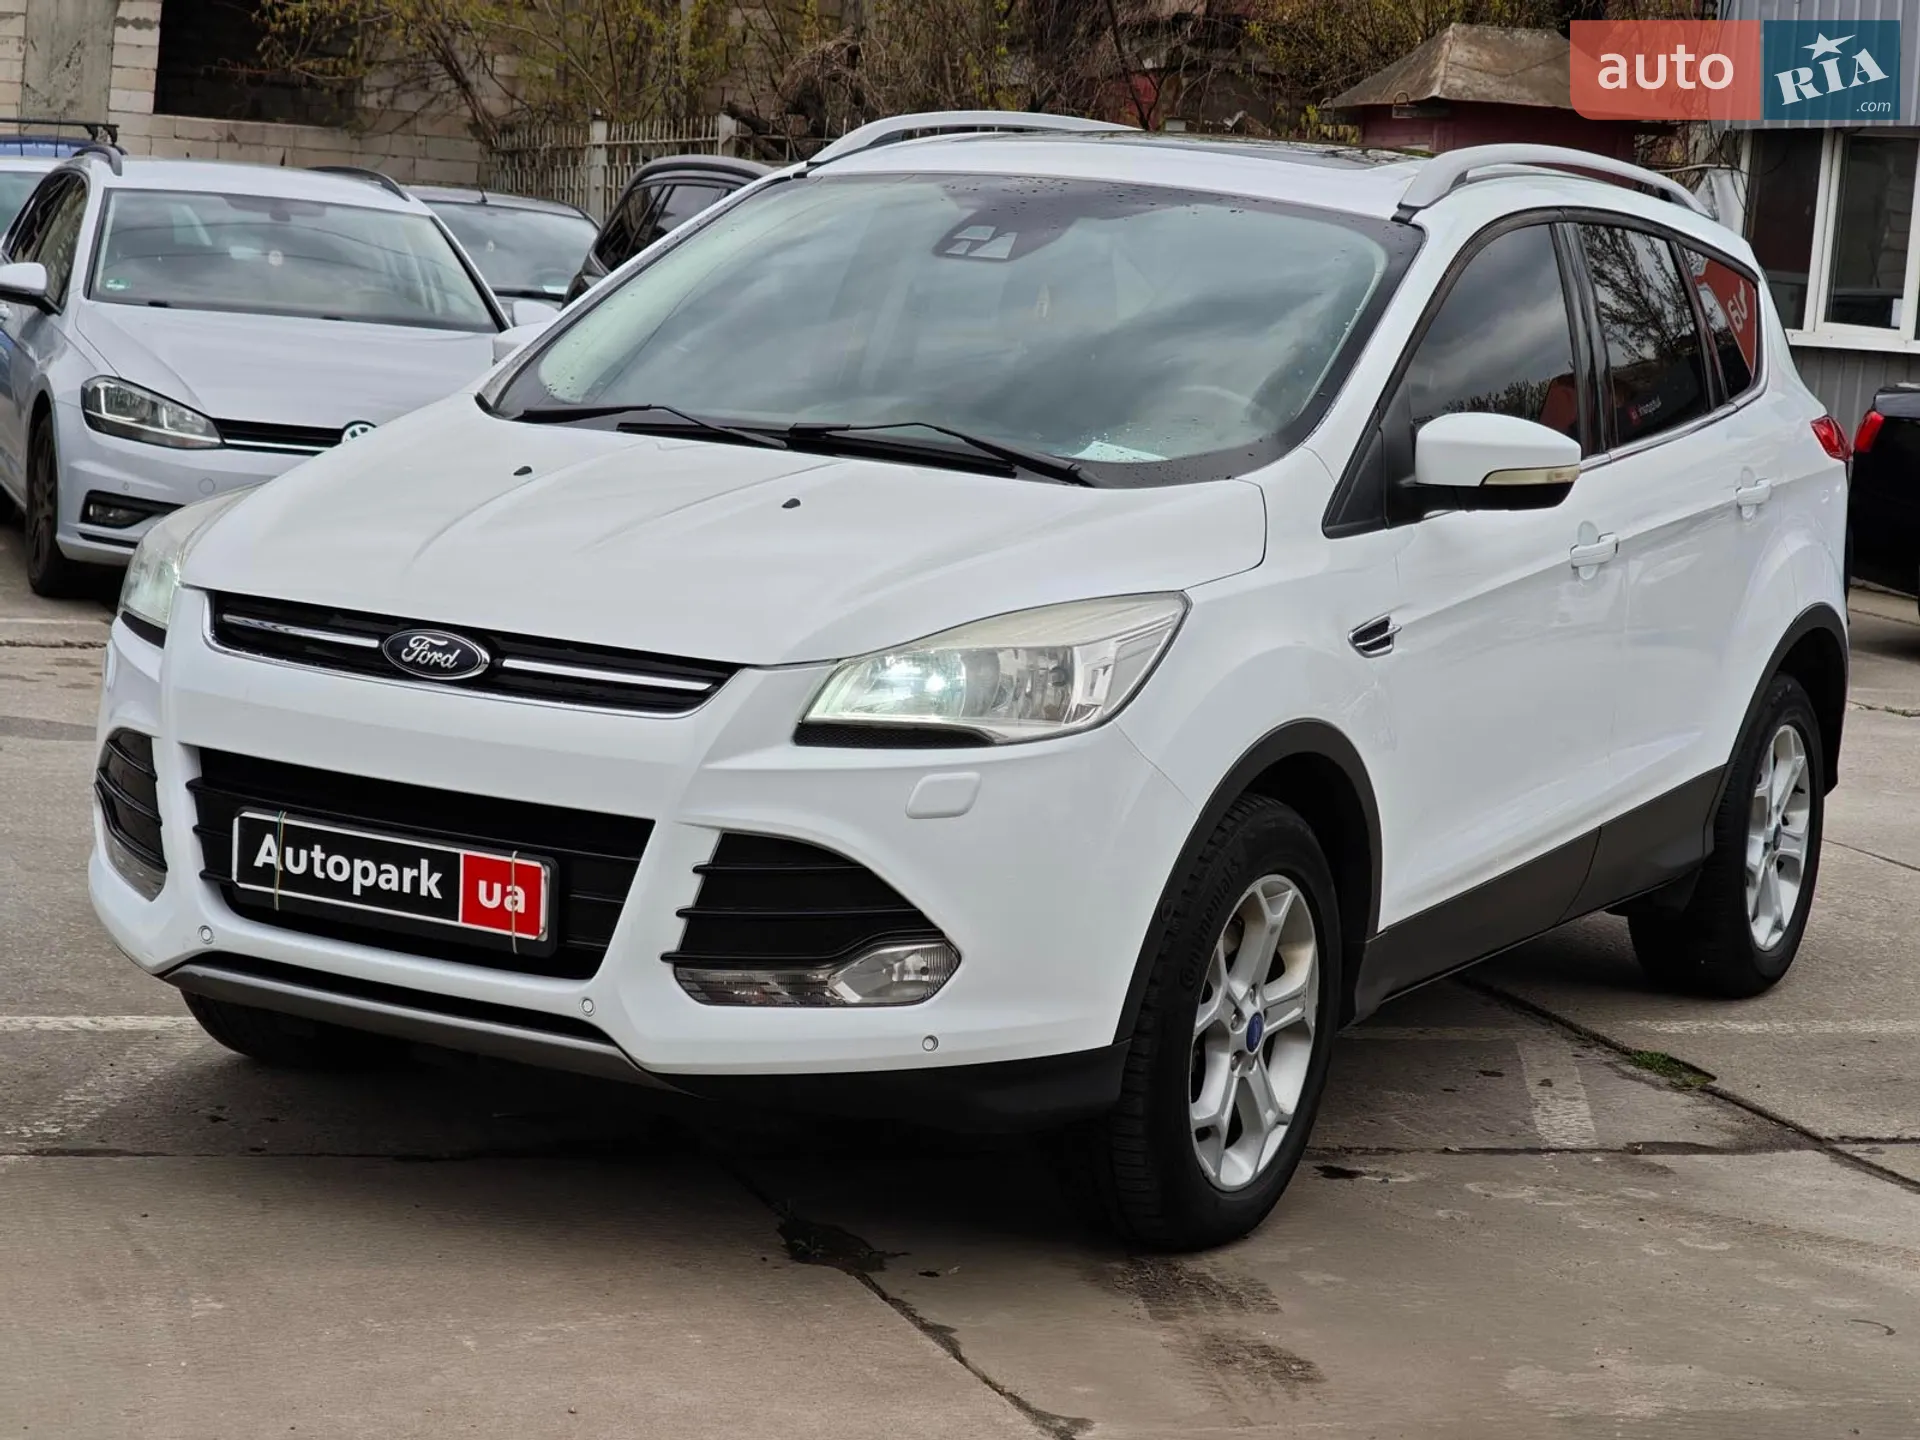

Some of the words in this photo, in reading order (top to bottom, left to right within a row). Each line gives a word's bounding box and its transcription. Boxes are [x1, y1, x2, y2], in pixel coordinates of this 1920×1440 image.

[401, 635, 460, 669] Ford
[253, 833, 443, 899] Autopark
[477, 879, 525, 914] ua
